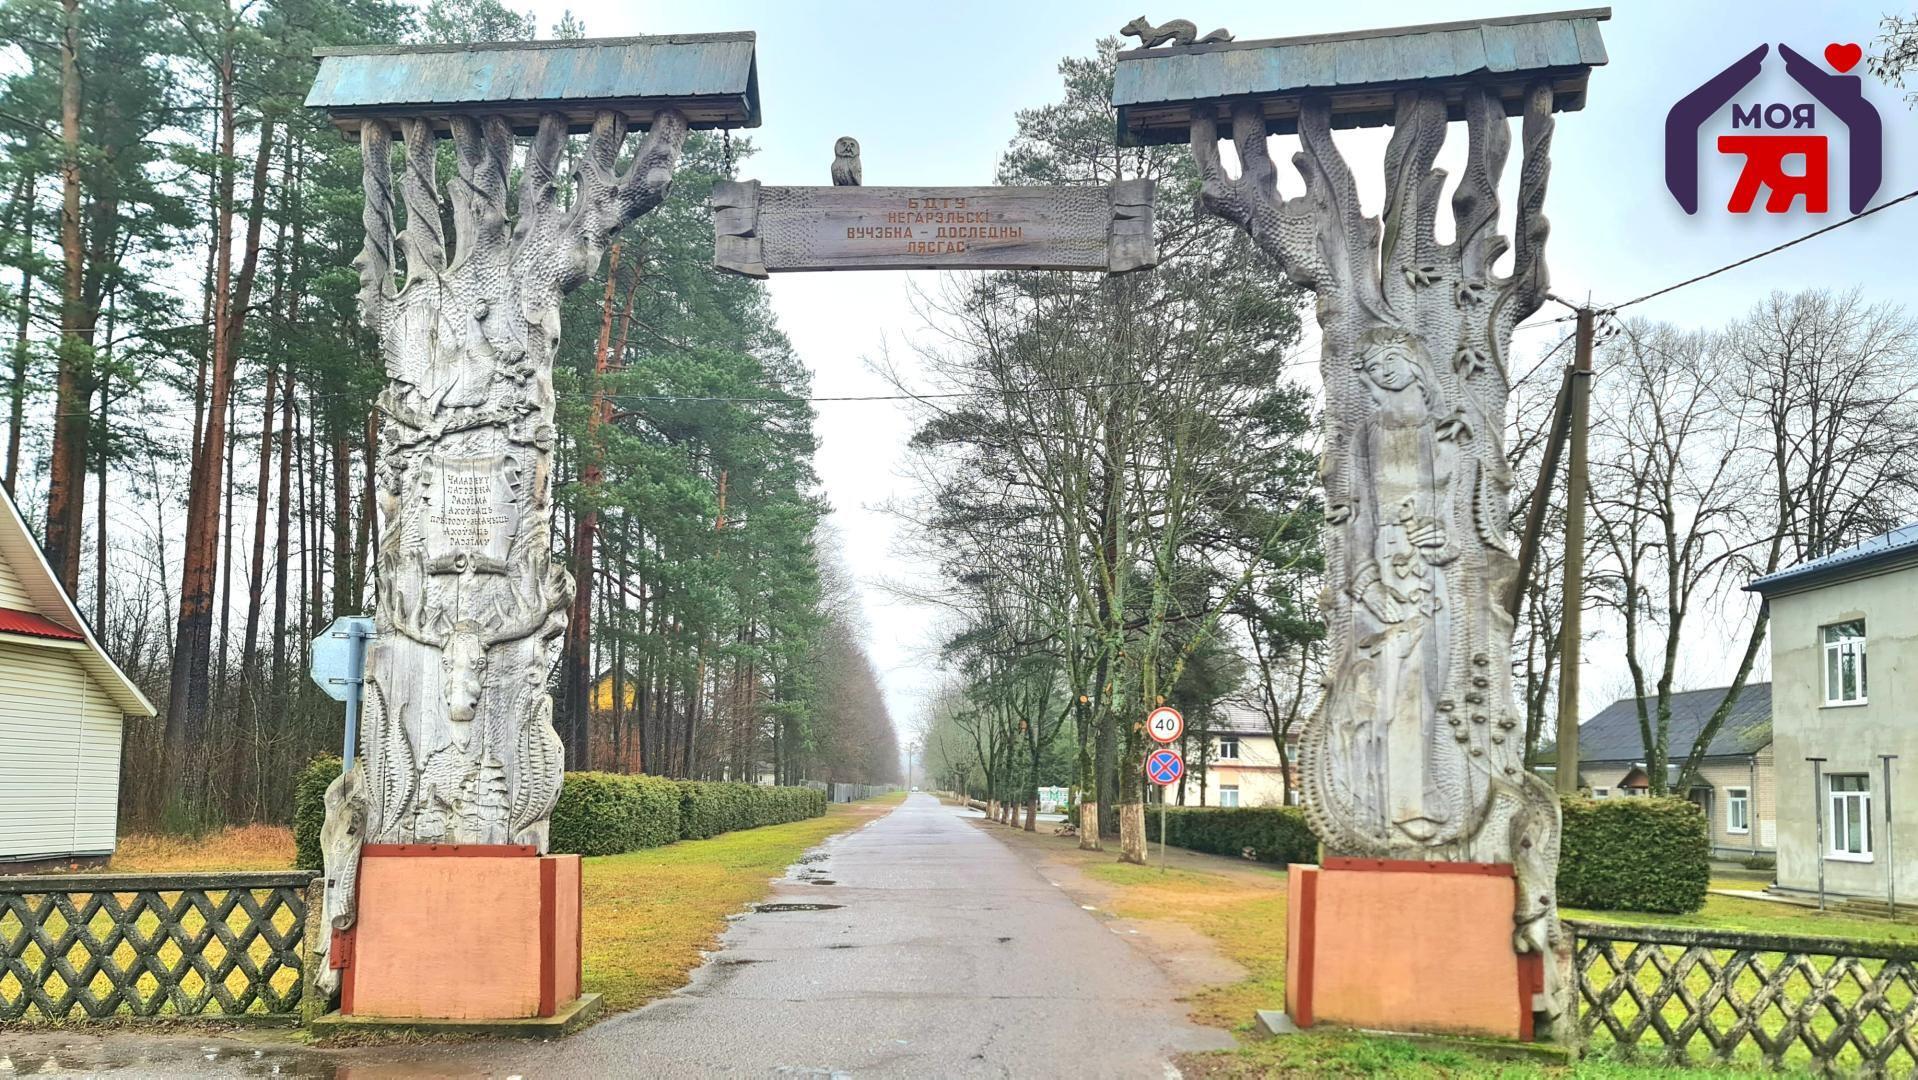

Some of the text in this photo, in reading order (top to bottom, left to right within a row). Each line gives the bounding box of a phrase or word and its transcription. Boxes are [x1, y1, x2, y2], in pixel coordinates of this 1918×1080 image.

[936, 226, 1022, 239] ДОСЛЕДНЫ
[907, 241, 965, 254] ЛЯСГАС
[1155, 718, 1175, 731] 40
